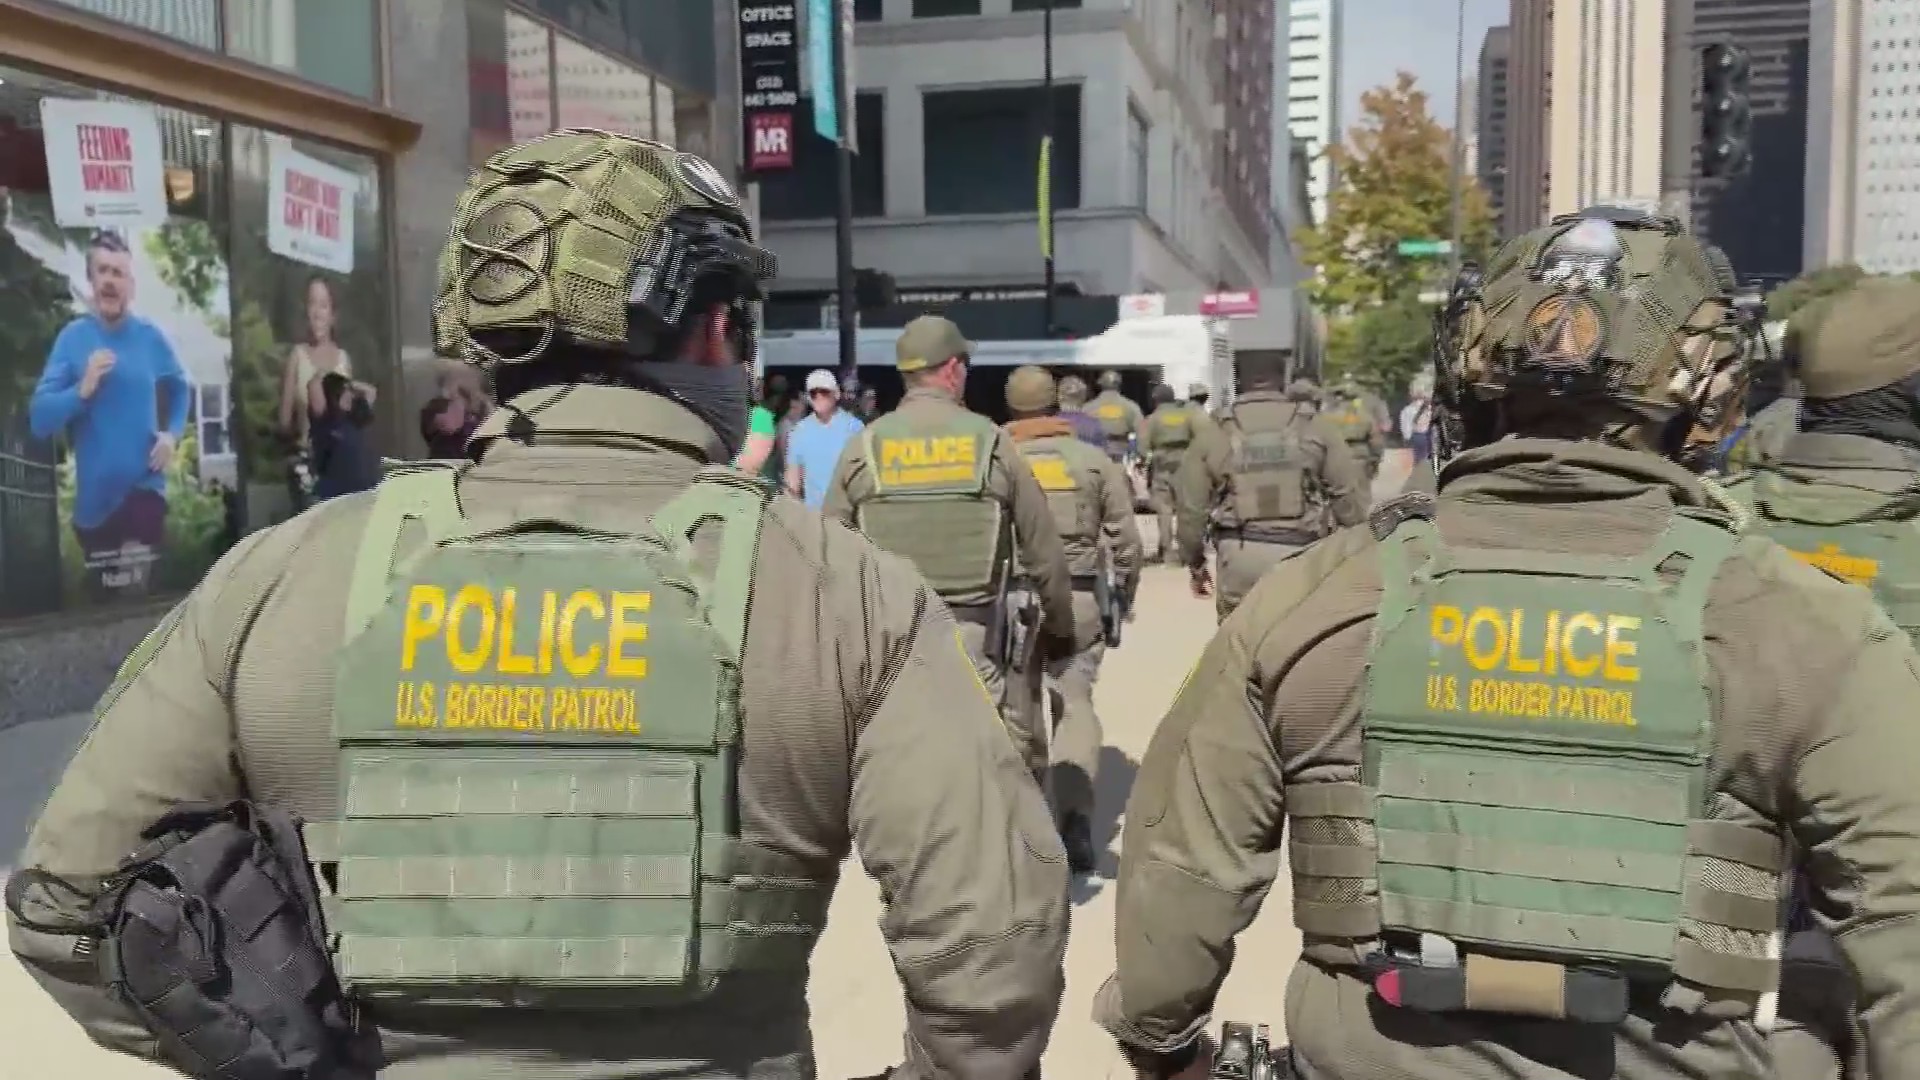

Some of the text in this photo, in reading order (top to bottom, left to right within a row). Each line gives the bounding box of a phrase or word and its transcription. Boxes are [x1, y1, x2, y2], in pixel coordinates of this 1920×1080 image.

[741, 5, 793, 22] OFFICE
[745, 32, 792, 47] SPACE
[76, 124, 132, 161] FEEDING
[755, 128, 788, 152] MR
[881, 434, 976, 466] POLICE
[401, 583, 651, 677] POLICE
[1429, 605, 1642, 681] POLICE
[396, 681, 641, 735] U.S. BORDER PATROL
[1427, 674, 1637, 727] U.S. BORDER PATROL
